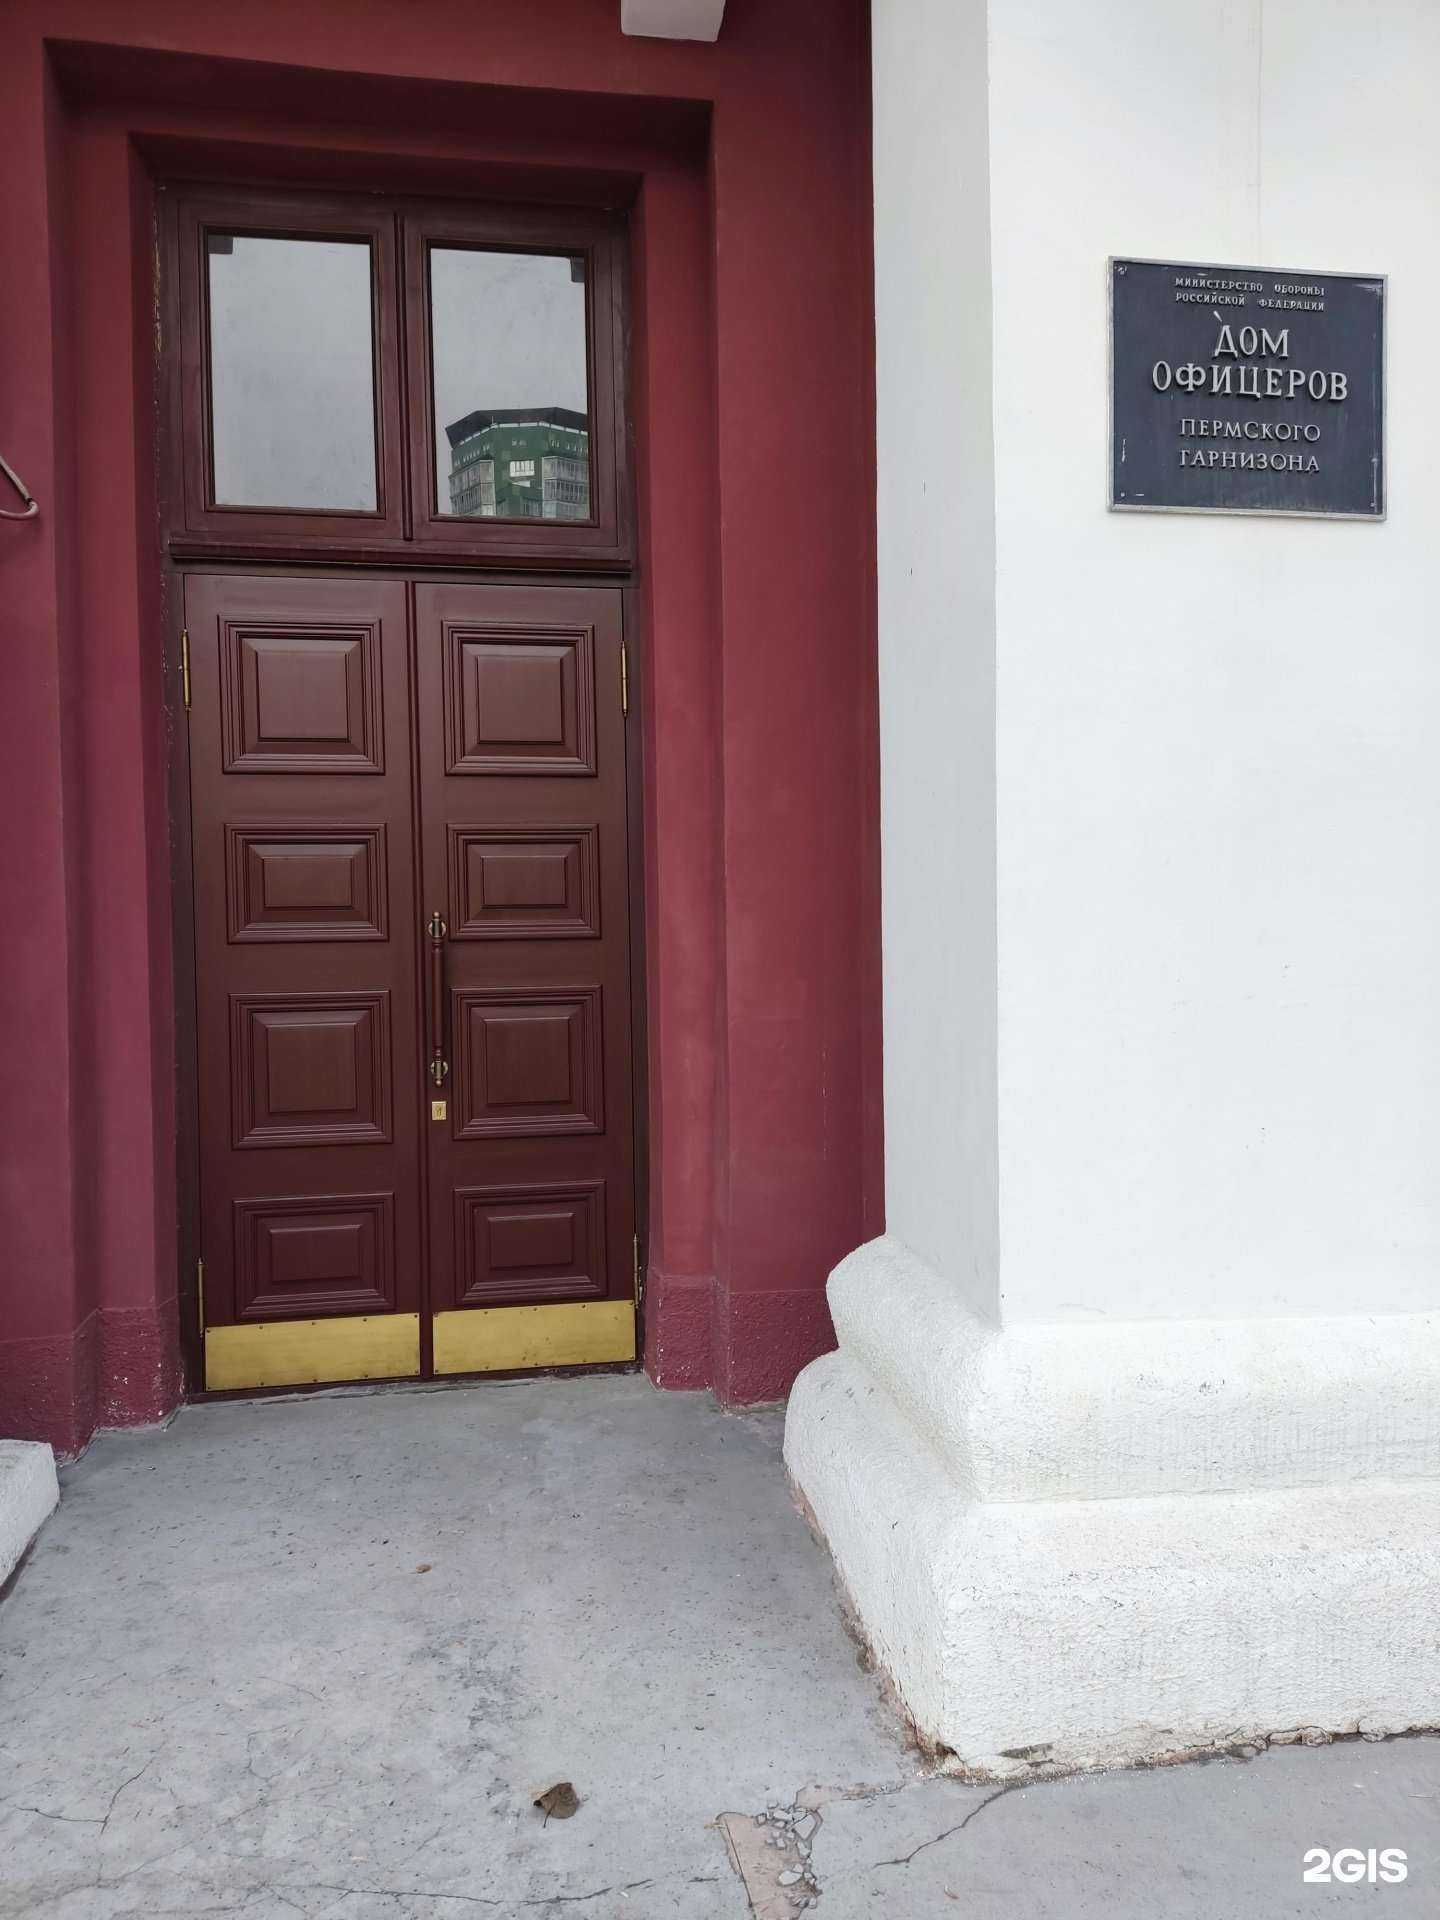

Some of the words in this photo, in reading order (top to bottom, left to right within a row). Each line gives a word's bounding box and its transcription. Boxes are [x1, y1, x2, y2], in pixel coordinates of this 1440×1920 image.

[1175, 277, 1263, 292] МИНИСТЕРСТВО
[1274, 284, 1325, 296] ОБОРОНЫ
[1175, 291, 1245, 306] РОССИЙСКОЙ
[1257, 298, 1325, 311] ФЕДЕРАЦИИ
[1211, 324, 1289, 359] ДОМ
[1152, 360, 1348, 401] ОФИЦЕРОВ
[1180, 418, 1321, 441] ПЕРМСКОГО
[1180, 449, 1320, 472] ГАРНИЗОНА
